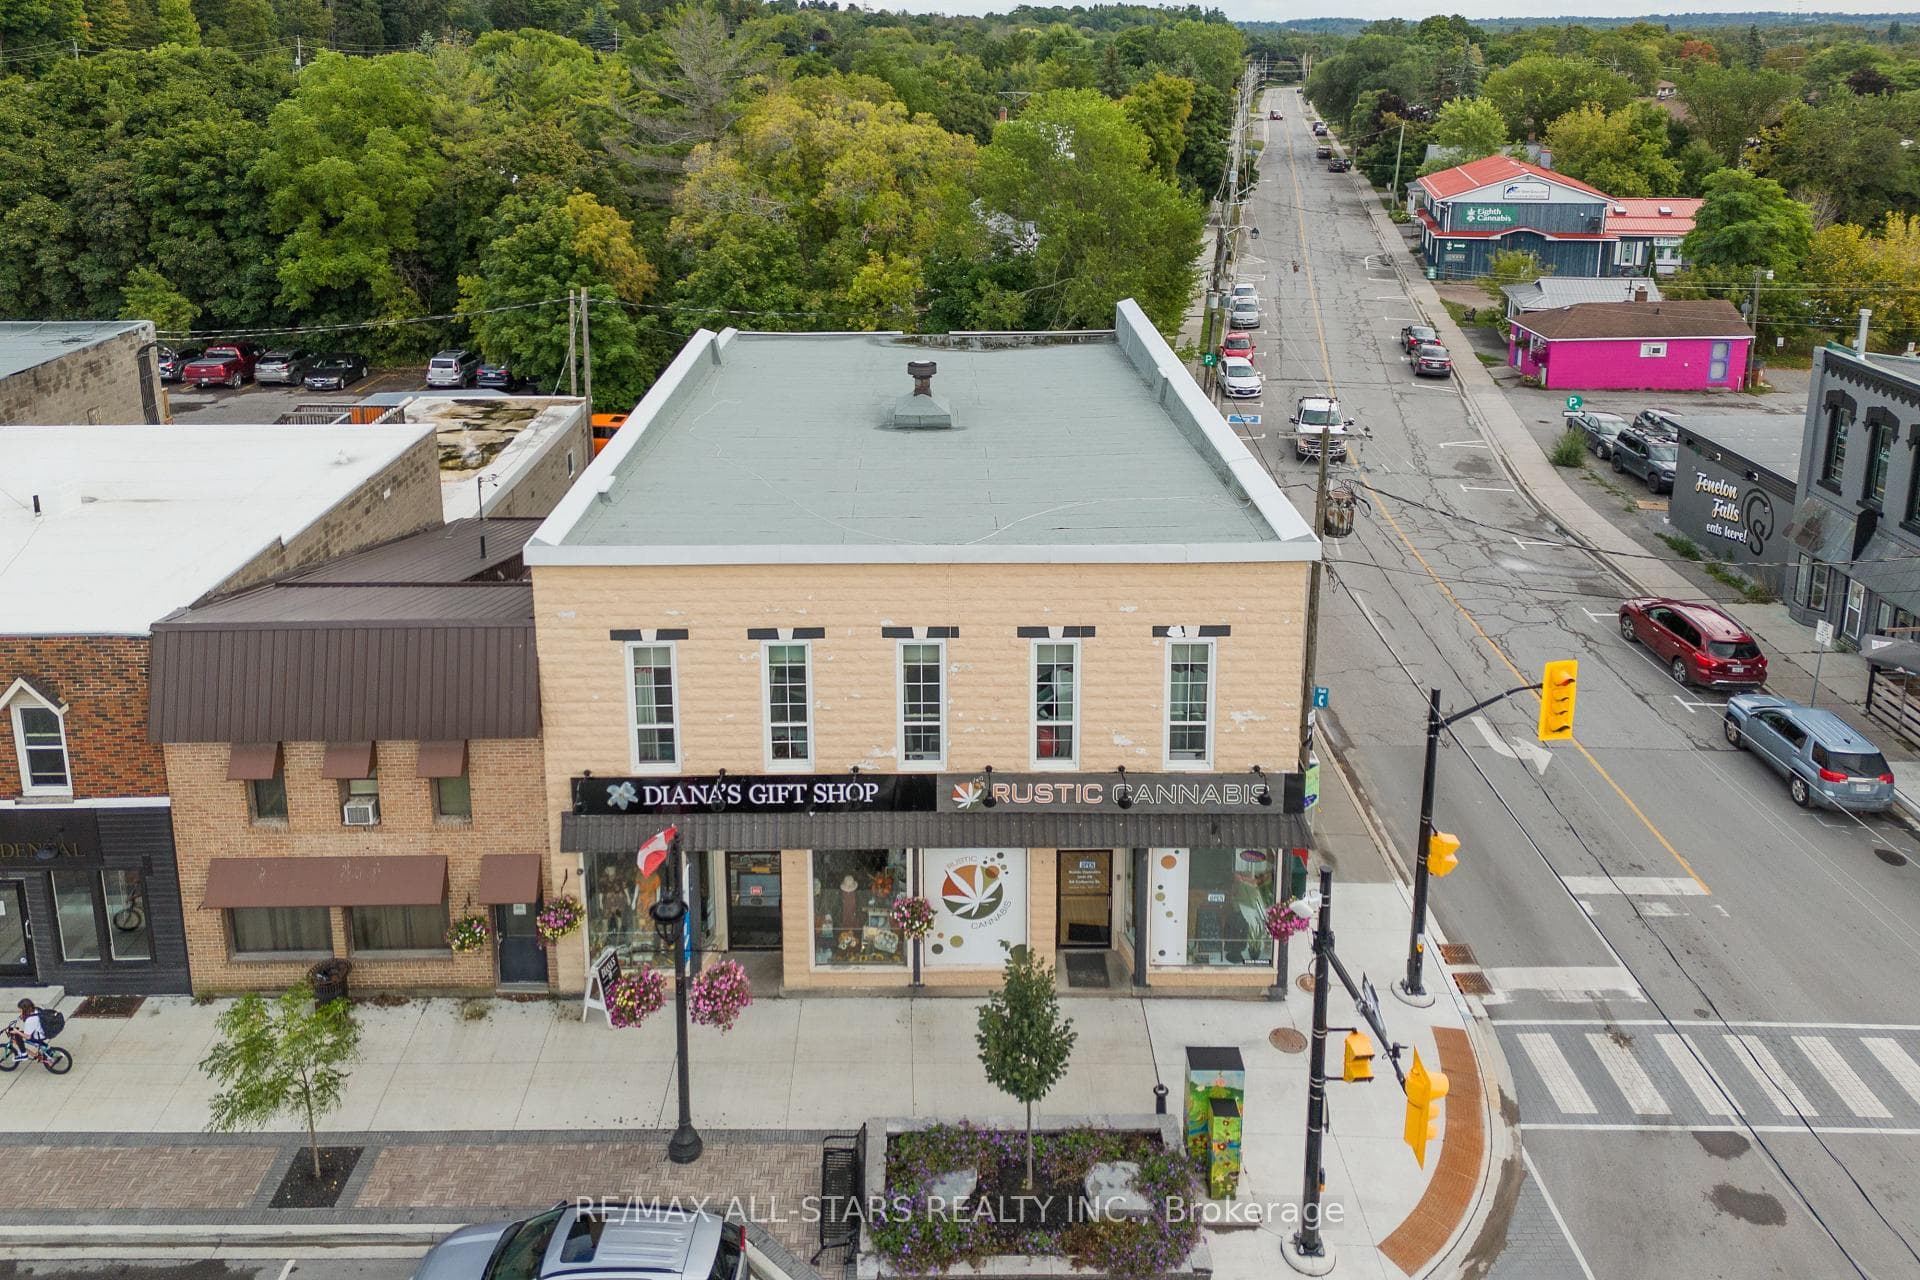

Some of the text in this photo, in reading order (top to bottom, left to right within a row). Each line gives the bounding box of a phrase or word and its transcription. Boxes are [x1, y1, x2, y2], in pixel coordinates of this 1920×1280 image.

[1477, 207, 1502, 217] Eighth
[1477, 214, 1512, 222] Cannabis
[1695, 471, 1738, 500] Fenelon
[1711, 497, 1740, 522] Falls
[1706, 522, 1748, 543] eats here!
[643, 782, 880, 806] DIANA'S GIFT SHOP
[991, 782, 1270, 806] RUSTIC CANNABIS
[970, 899, 1013, 930] CANNABIS
